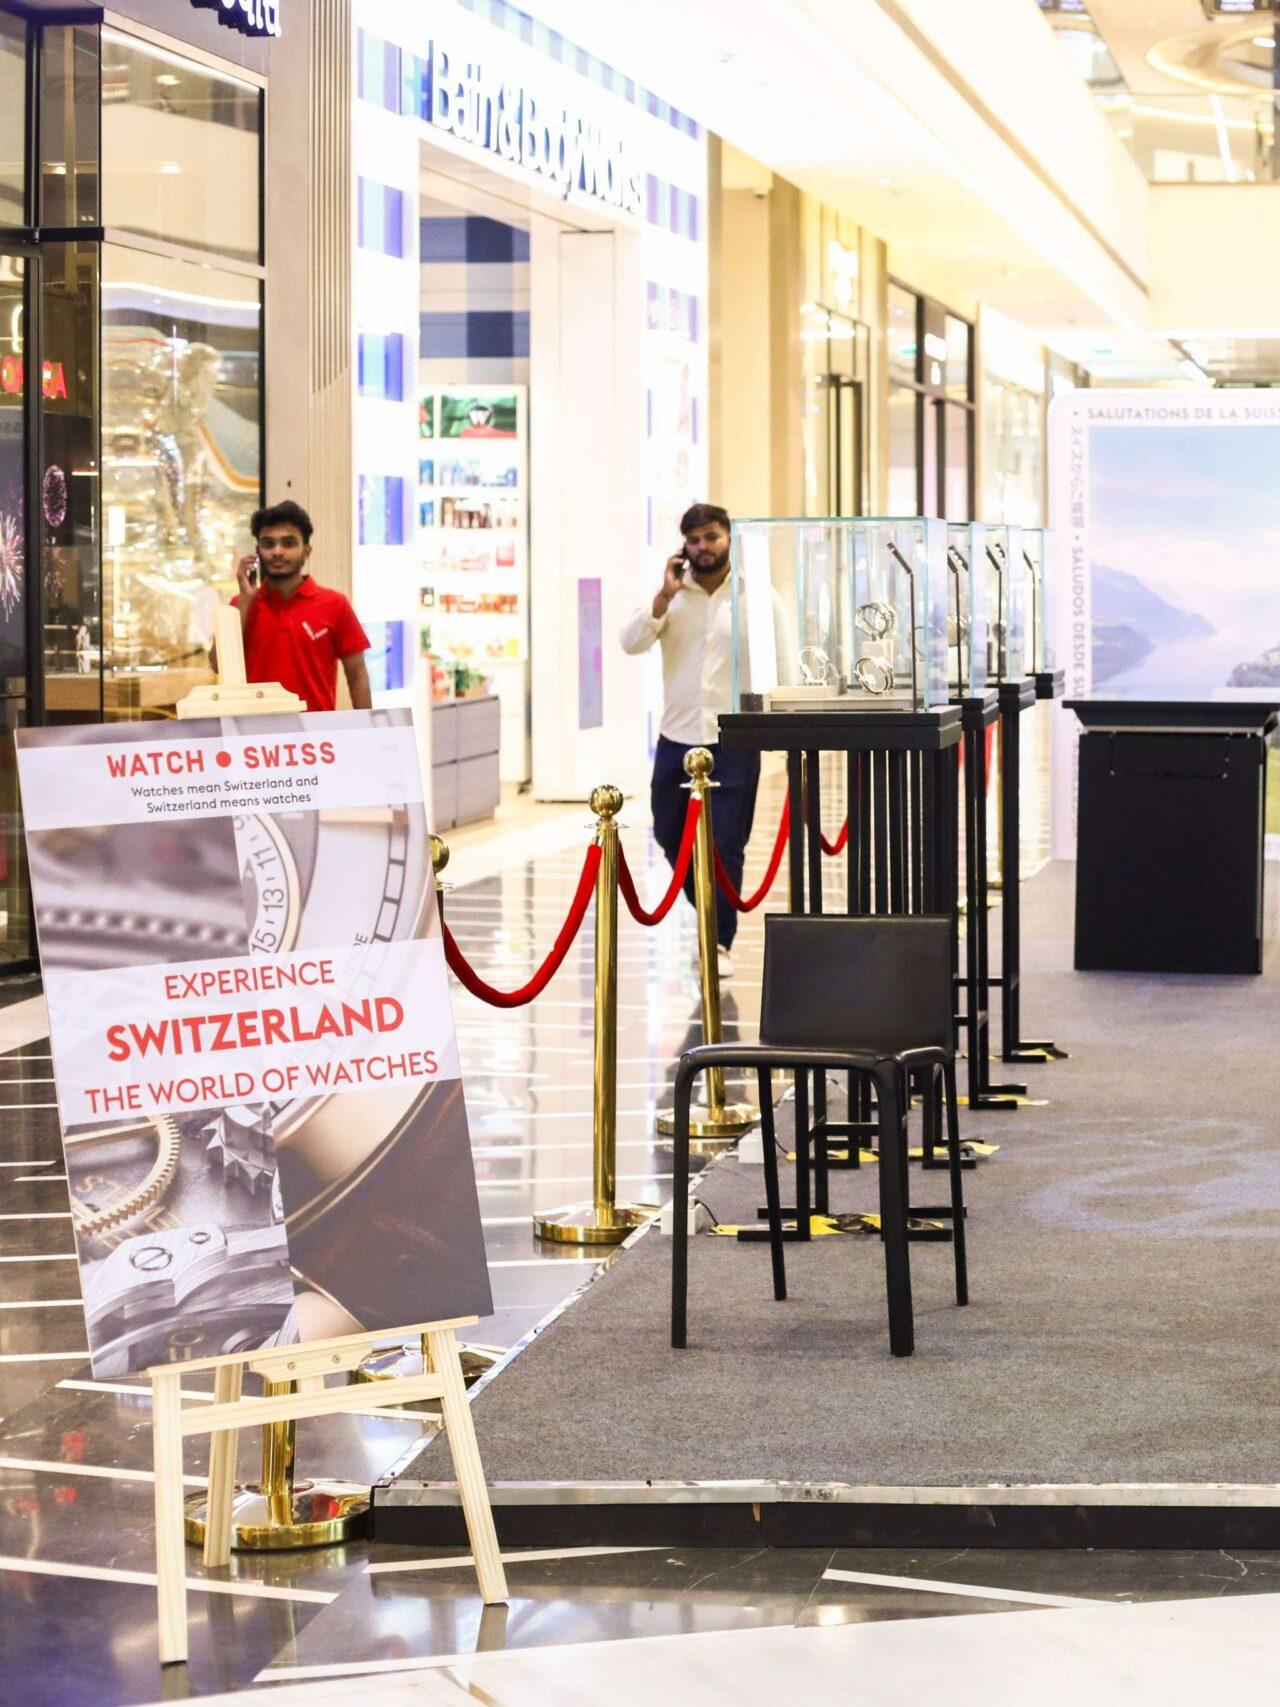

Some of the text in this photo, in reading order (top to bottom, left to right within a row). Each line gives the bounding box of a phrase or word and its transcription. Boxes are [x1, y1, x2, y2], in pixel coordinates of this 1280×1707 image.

[1087, 407, 1189, 419] SALUTATIONS
[1195, 407, 1213, 419] DE
[1220, 407, 1238, 418] LA
[1072, 547, 1085, 617] SALUDOS
[1072, 622, 1085, 671] DESDE
[106, 741, 336, 778] WATCH SWISS
[131, 776, 319, 797] Watches mean Switzerland and
[147, 793, 312, 813] Switzerland means watches
[262, 888, 285, 913] 13
[251, 928, 277, 954] 15
[164, 960, 336, 1000] EXPERIENCE
[106, 996, 405, 1062] SWITZERLAND
[85, 1050, 439, 1114] THE WORLD OF WATCHES
